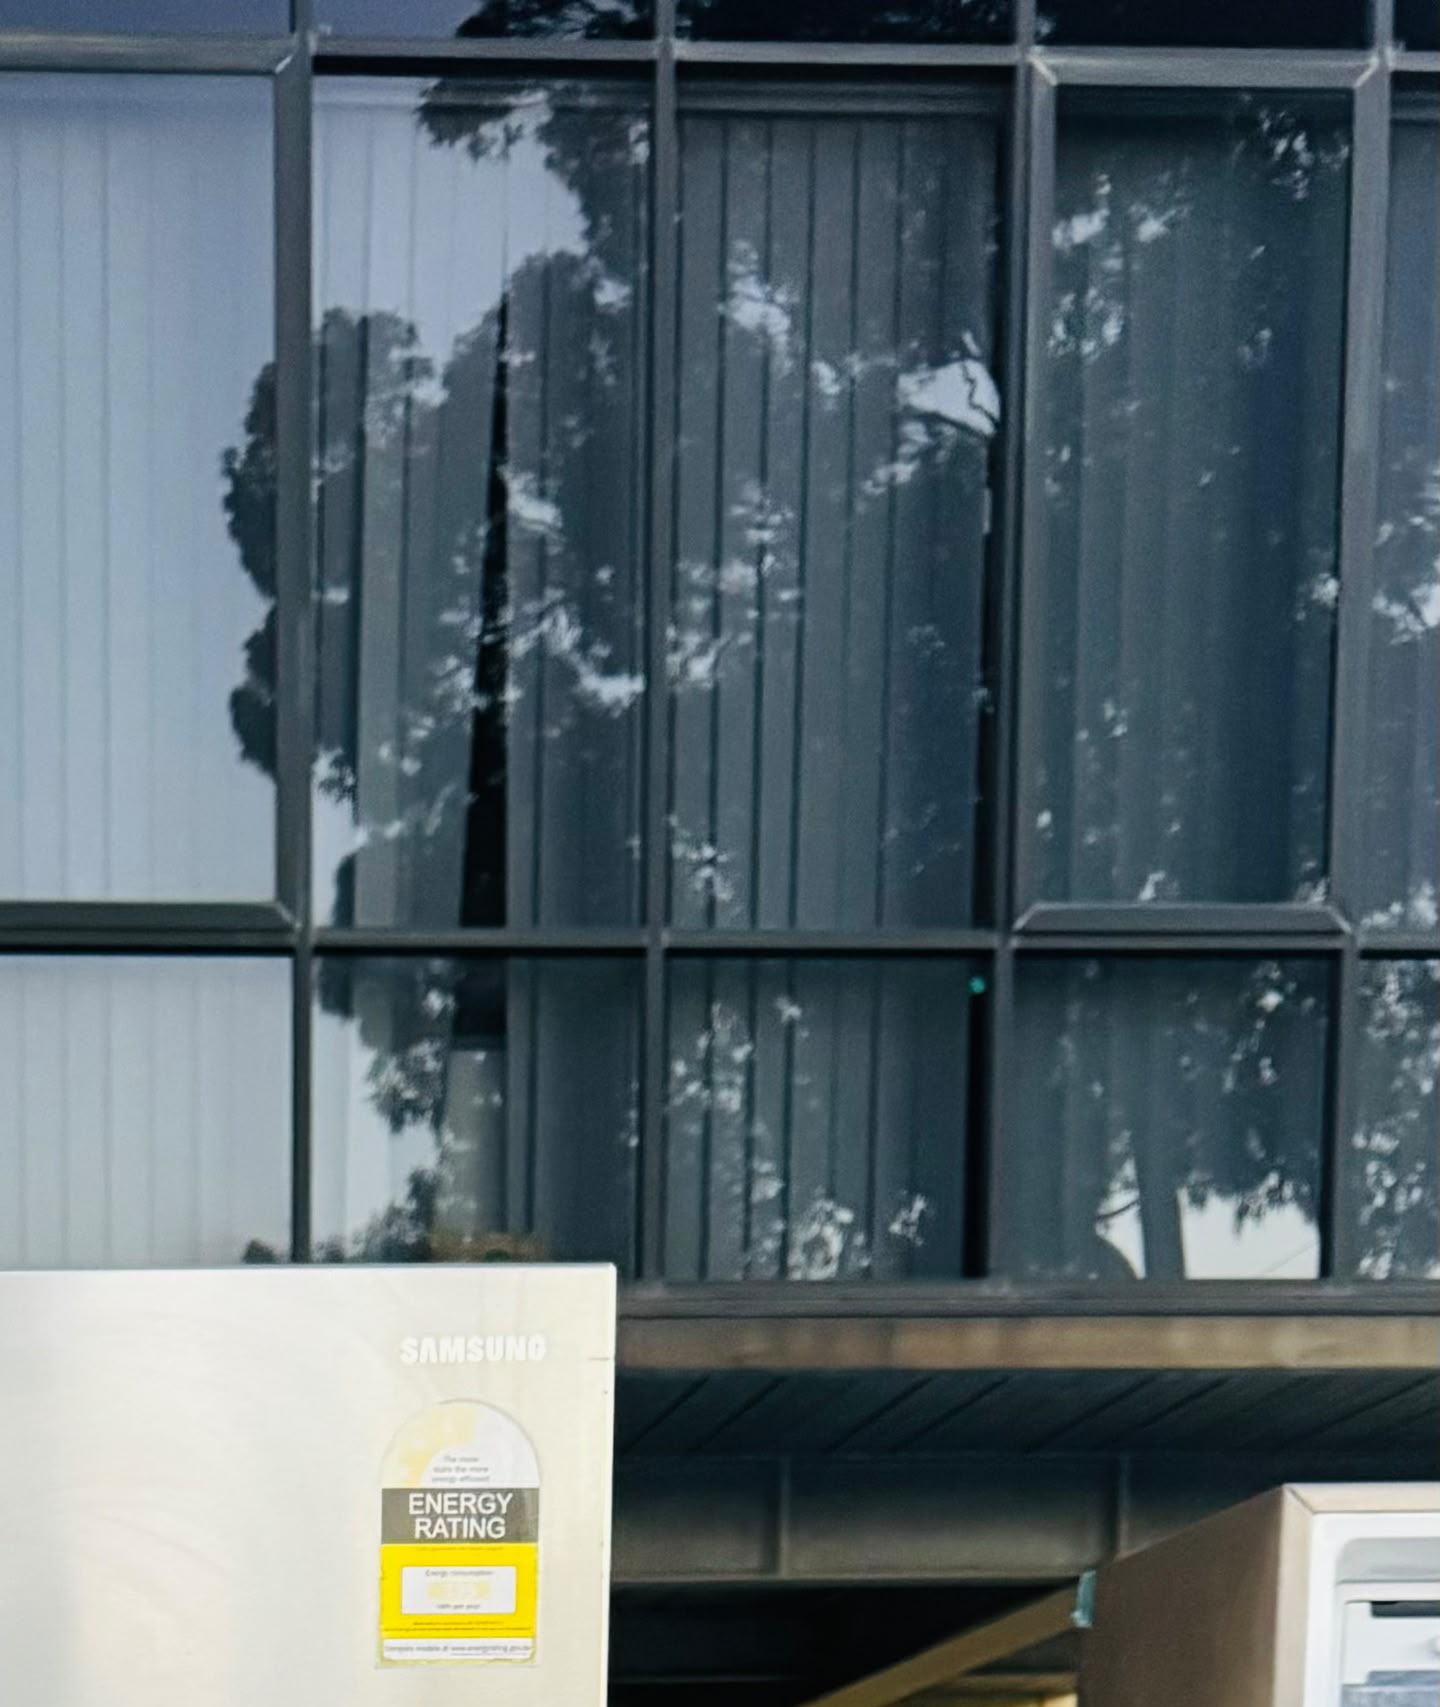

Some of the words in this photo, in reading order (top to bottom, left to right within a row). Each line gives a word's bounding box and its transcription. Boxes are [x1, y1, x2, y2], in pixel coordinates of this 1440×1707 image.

[400, 1334, 547, 1363] SAMSUNG
[409, 1492, 513, 1515] ENERGY
[414, 1516, 506, 1539] RATING
